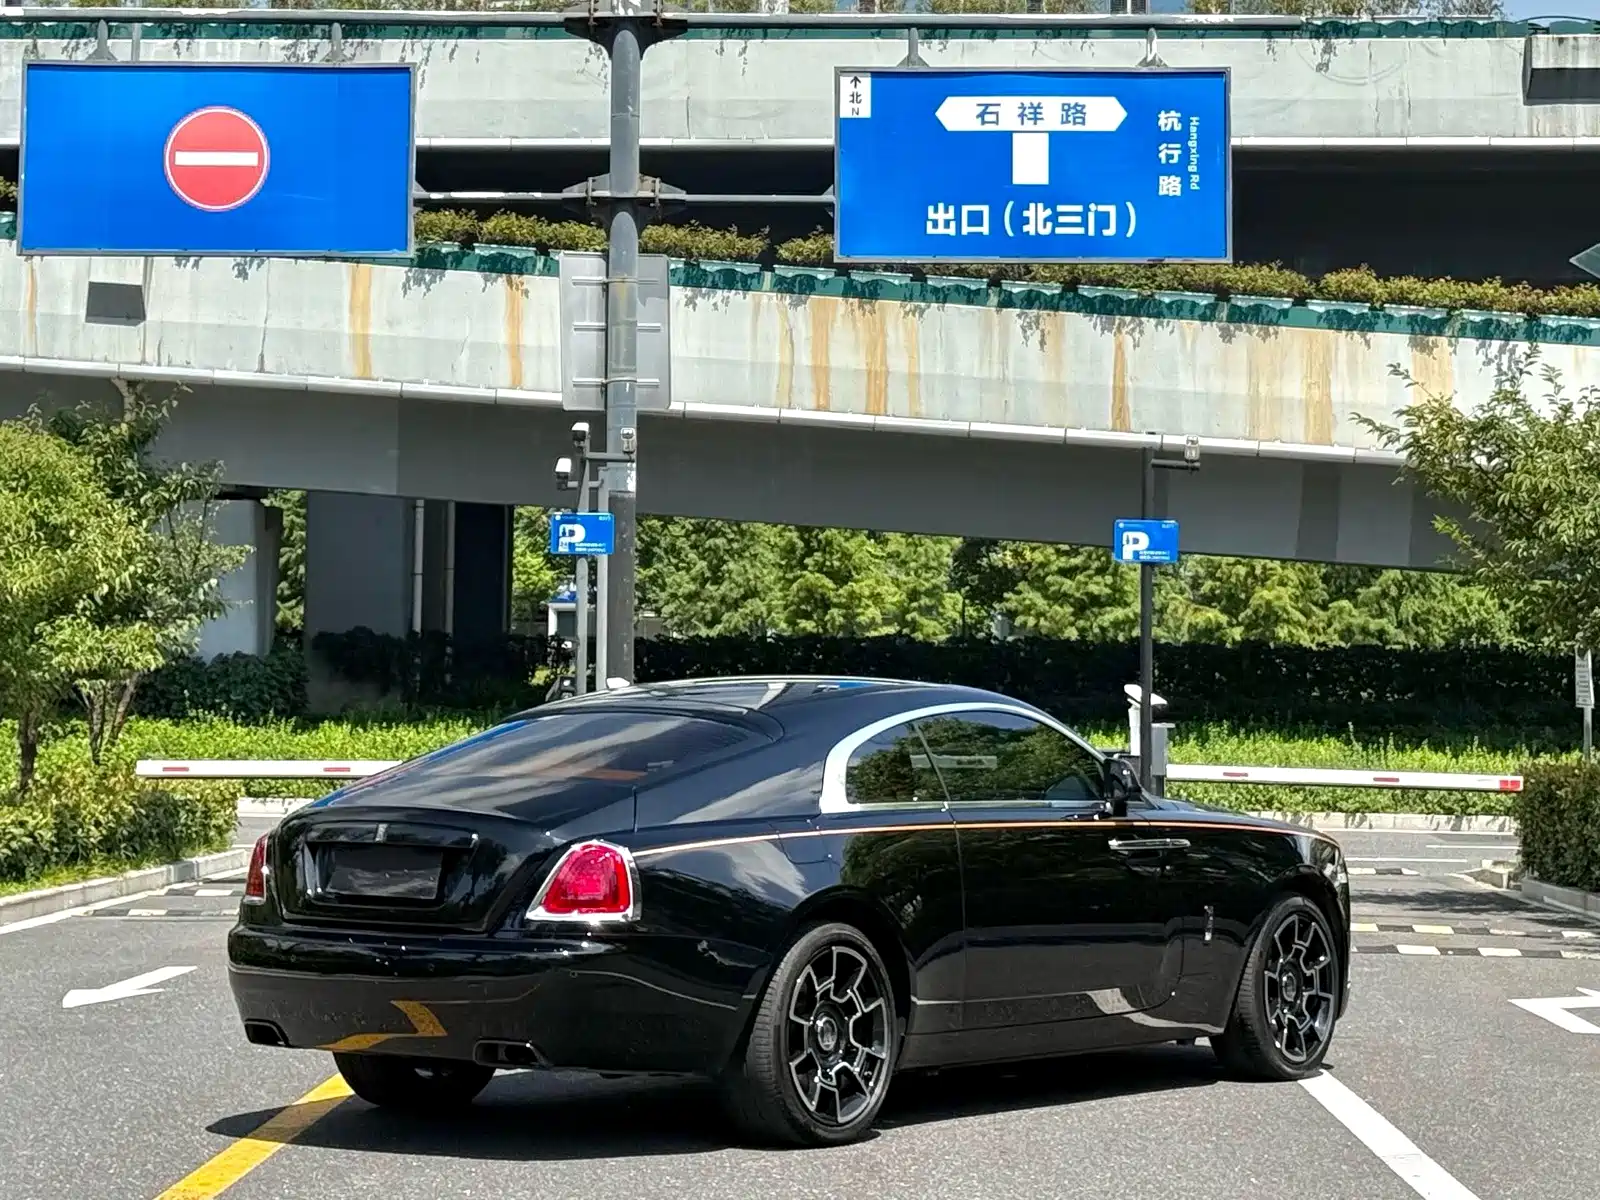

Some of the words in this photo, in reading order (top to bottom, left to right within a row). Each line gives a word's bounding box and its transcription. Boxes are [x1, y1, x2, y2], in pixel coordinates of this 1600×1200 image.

[849, 91, 862, 104] 北
[851, 107, 860, 116] N
[975, 102, 1087, 126] 石祥路
[1158, 110, 1182, 197] 杭行路
[1187, 116, 1200, 172] Hangxing
[1189, 174, 1200, 190] Rd
[558, 523, 586, 552] P
[1122, 531, 1150, 560] P
